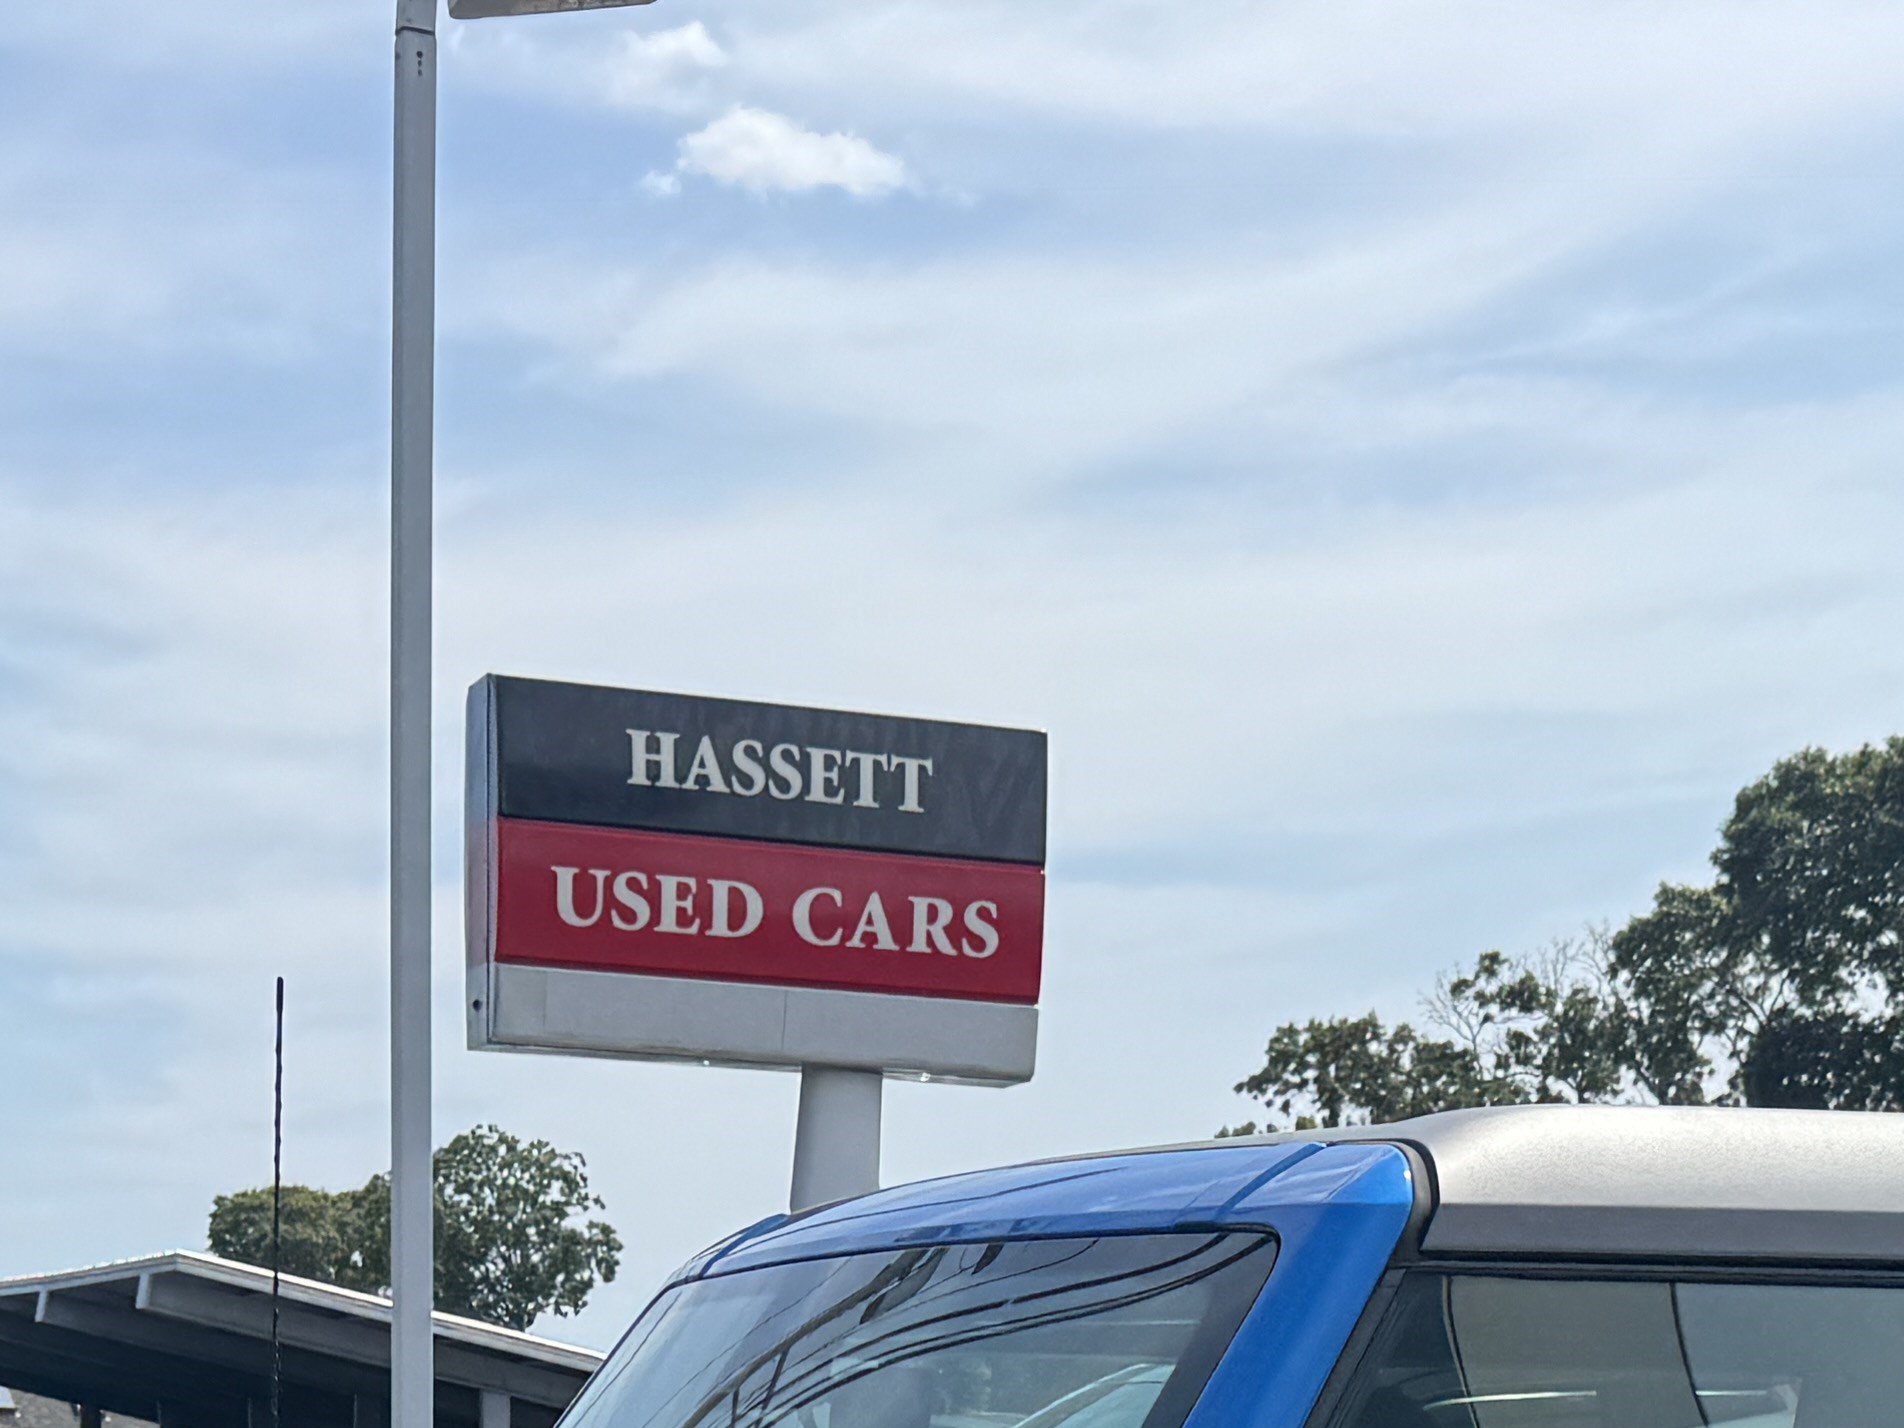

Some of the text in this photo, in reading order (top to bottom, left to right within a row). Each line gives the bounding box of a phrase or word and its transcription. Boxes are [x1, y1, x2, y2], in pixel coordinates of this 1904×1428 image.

[625, 728, 934, 814] HASSETT
[550, 866, 999, 960] USED CARS
